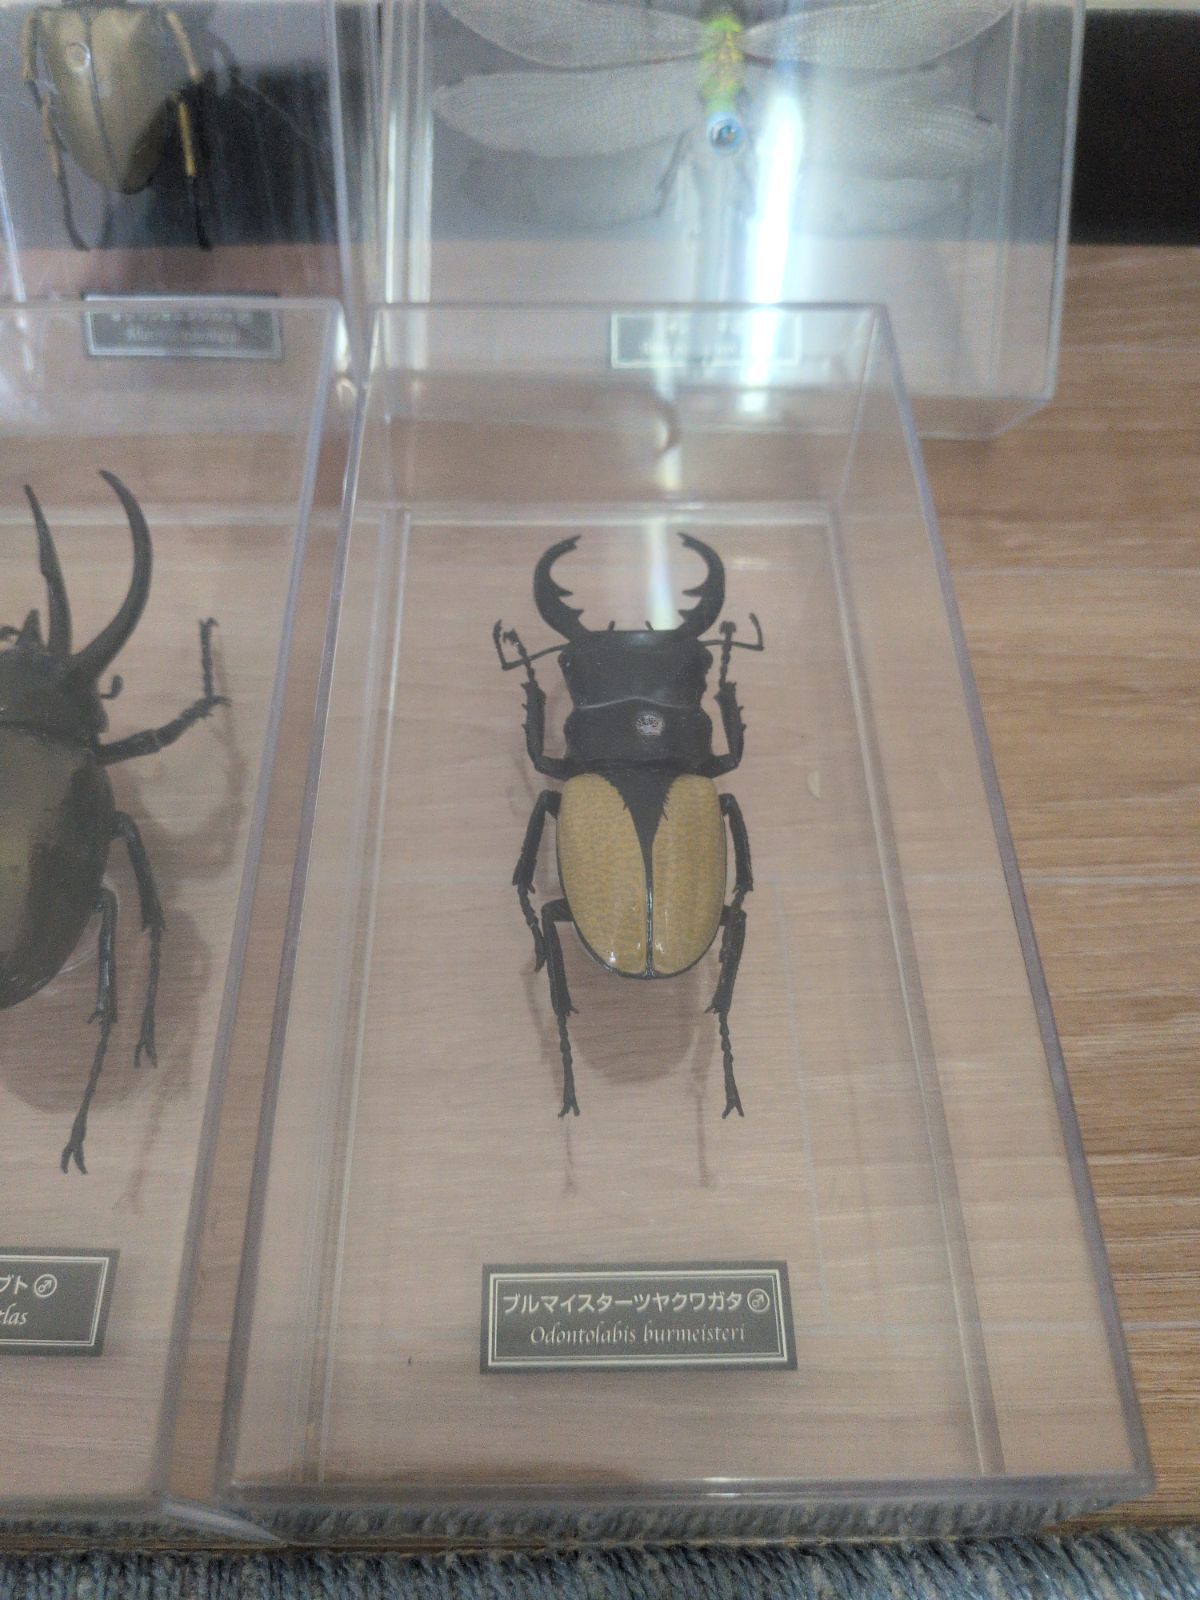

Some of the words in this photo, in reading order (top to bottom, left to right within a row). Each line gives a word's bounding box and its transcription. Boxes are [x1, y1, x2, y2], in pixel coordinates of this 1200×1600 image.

[502, 1291, 742, 1314] ブルマイスターツヤクワガタ
[530, 1320, 636, 1345] Odontolabis
[643, 1320, 745, 1344] burmeisteri
